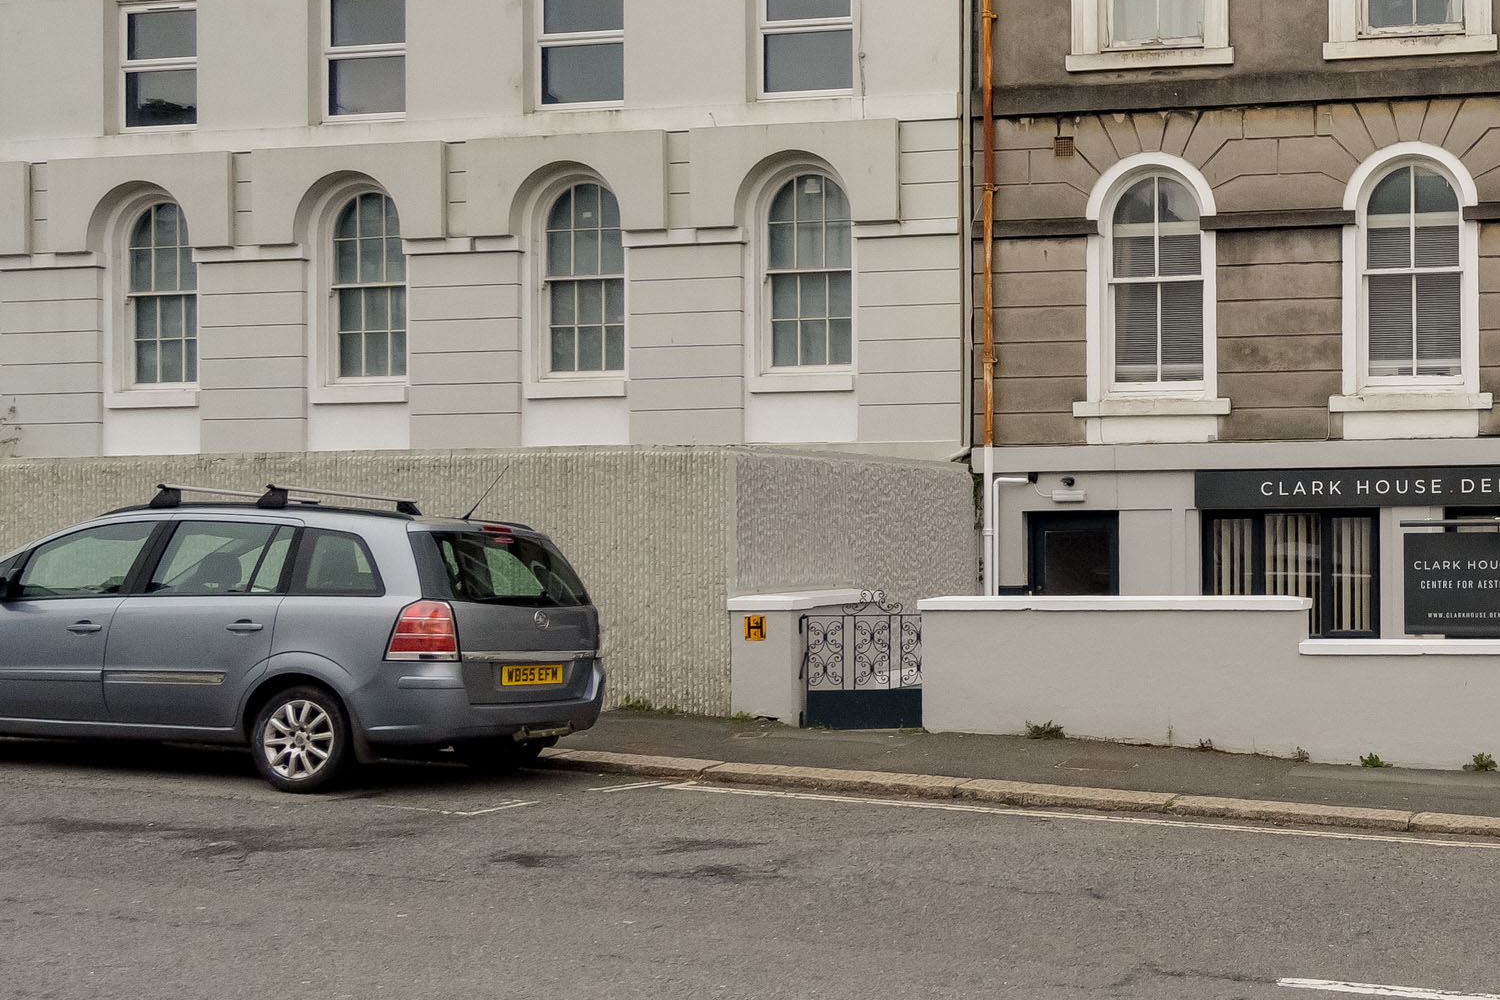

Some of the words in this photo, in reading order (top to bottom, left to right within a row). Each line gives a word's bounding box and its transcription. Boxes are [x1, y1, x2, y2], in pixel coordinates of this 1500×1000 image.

[1260, 480, 1342, 496] CLARK
[1413, 560, 1461, 571] CLARK
[1420, 580, 1453, 590] CENTRE
[1457, 580, 1474, 590] FOR
[747, 616, 763, 638] H
